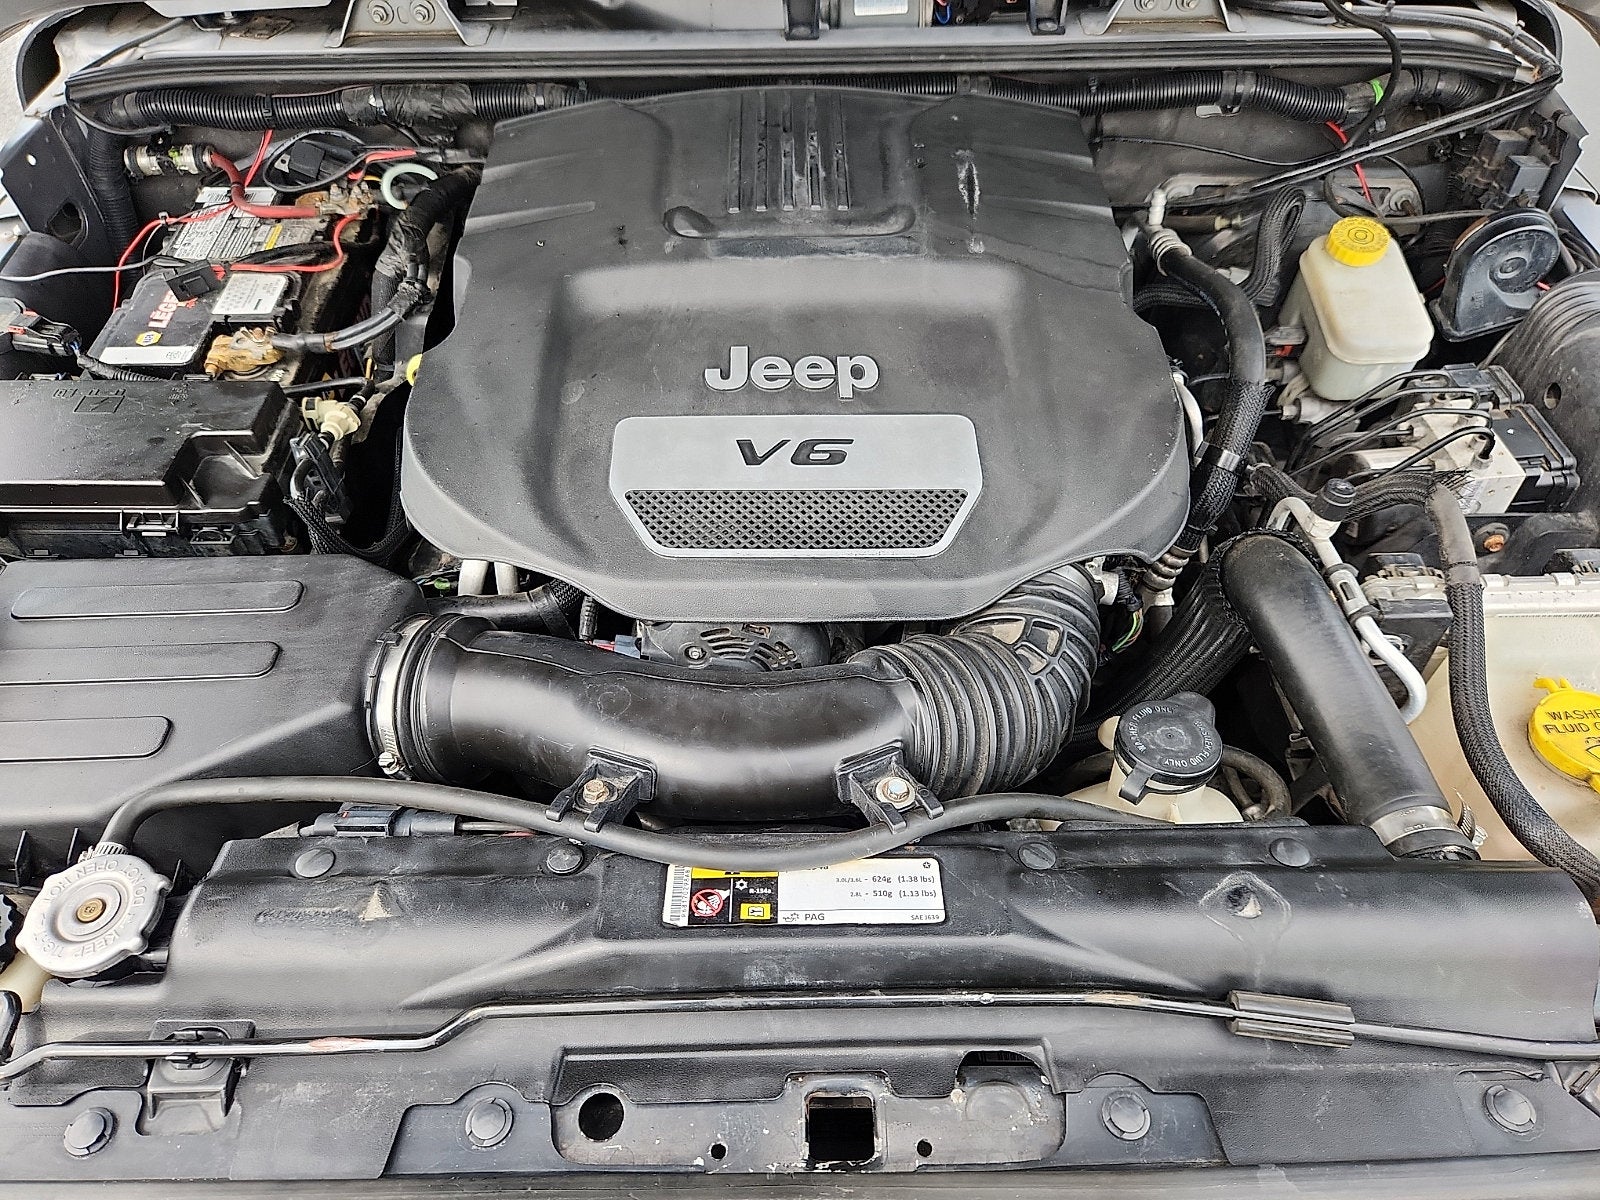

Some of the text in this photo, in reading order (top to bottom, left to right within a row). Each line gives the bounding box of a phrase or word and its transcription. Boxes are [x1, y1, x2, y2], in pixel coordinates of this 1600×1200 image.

[704, 345, 879, 400] Jeep
[736, 438, 854, 466] V6
[1132, 706, 1152, 723] FLUID
[1543, 722, 1590, 734] FLUID
[1164, 758, 1188, 767] ONLY
[1189, 750, 1210, 766] FLUID
[43, 859, 147, 907] DO NOT OPEN HOT
[872, 875, 892, 884] 624g
[898, 875, 919, 884] (1.38
[920, 875, 935, 884] lbs)
[872, 890, 893, 898] 510g
[899, 890, 919, 898] (1.13
[921, 890, 937, 898] lbs)
[804, 913, 825, 922] PAG
[74, 930, 120, 958] KEEP
